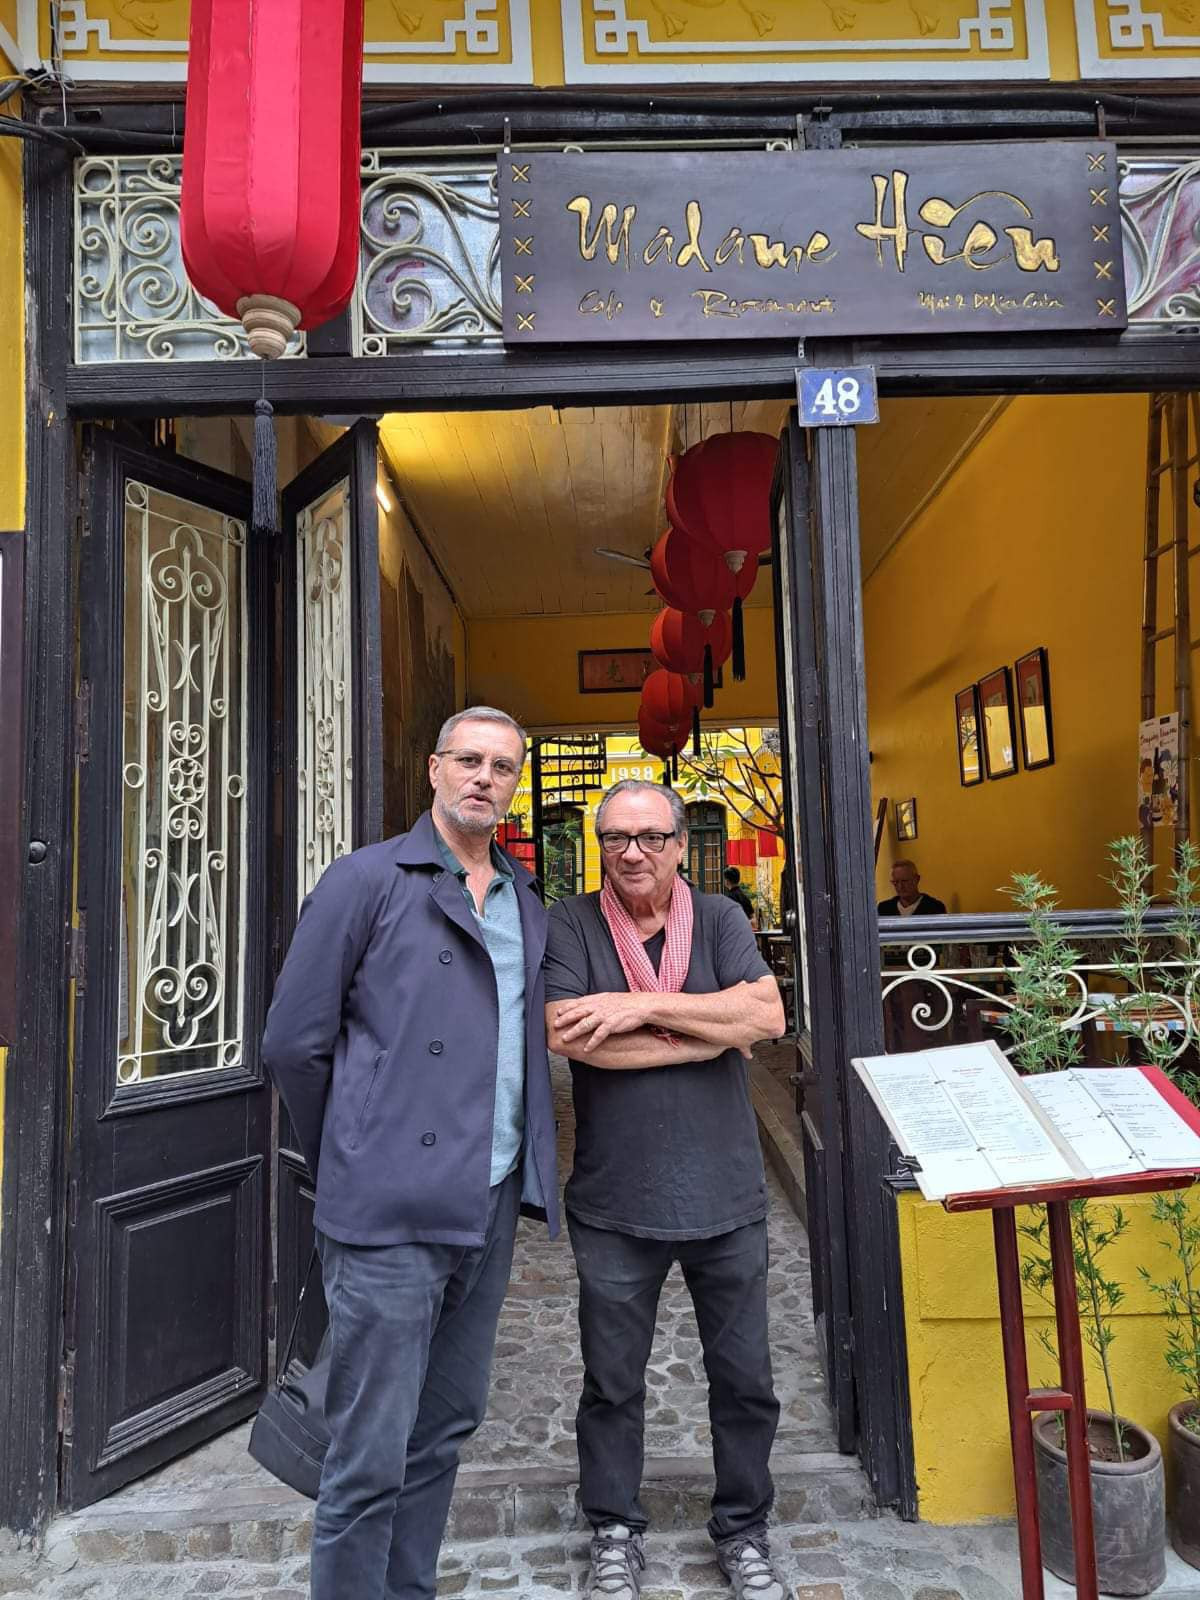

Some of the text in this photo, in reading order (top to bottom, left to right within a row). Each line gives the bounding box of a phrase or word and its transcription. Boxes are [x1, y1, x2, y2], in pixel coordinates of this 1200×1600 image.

[567, 195, 837, 273] Madame
[811, 377, 860, 415] 48
[611, 766, 653, 784] 1928
